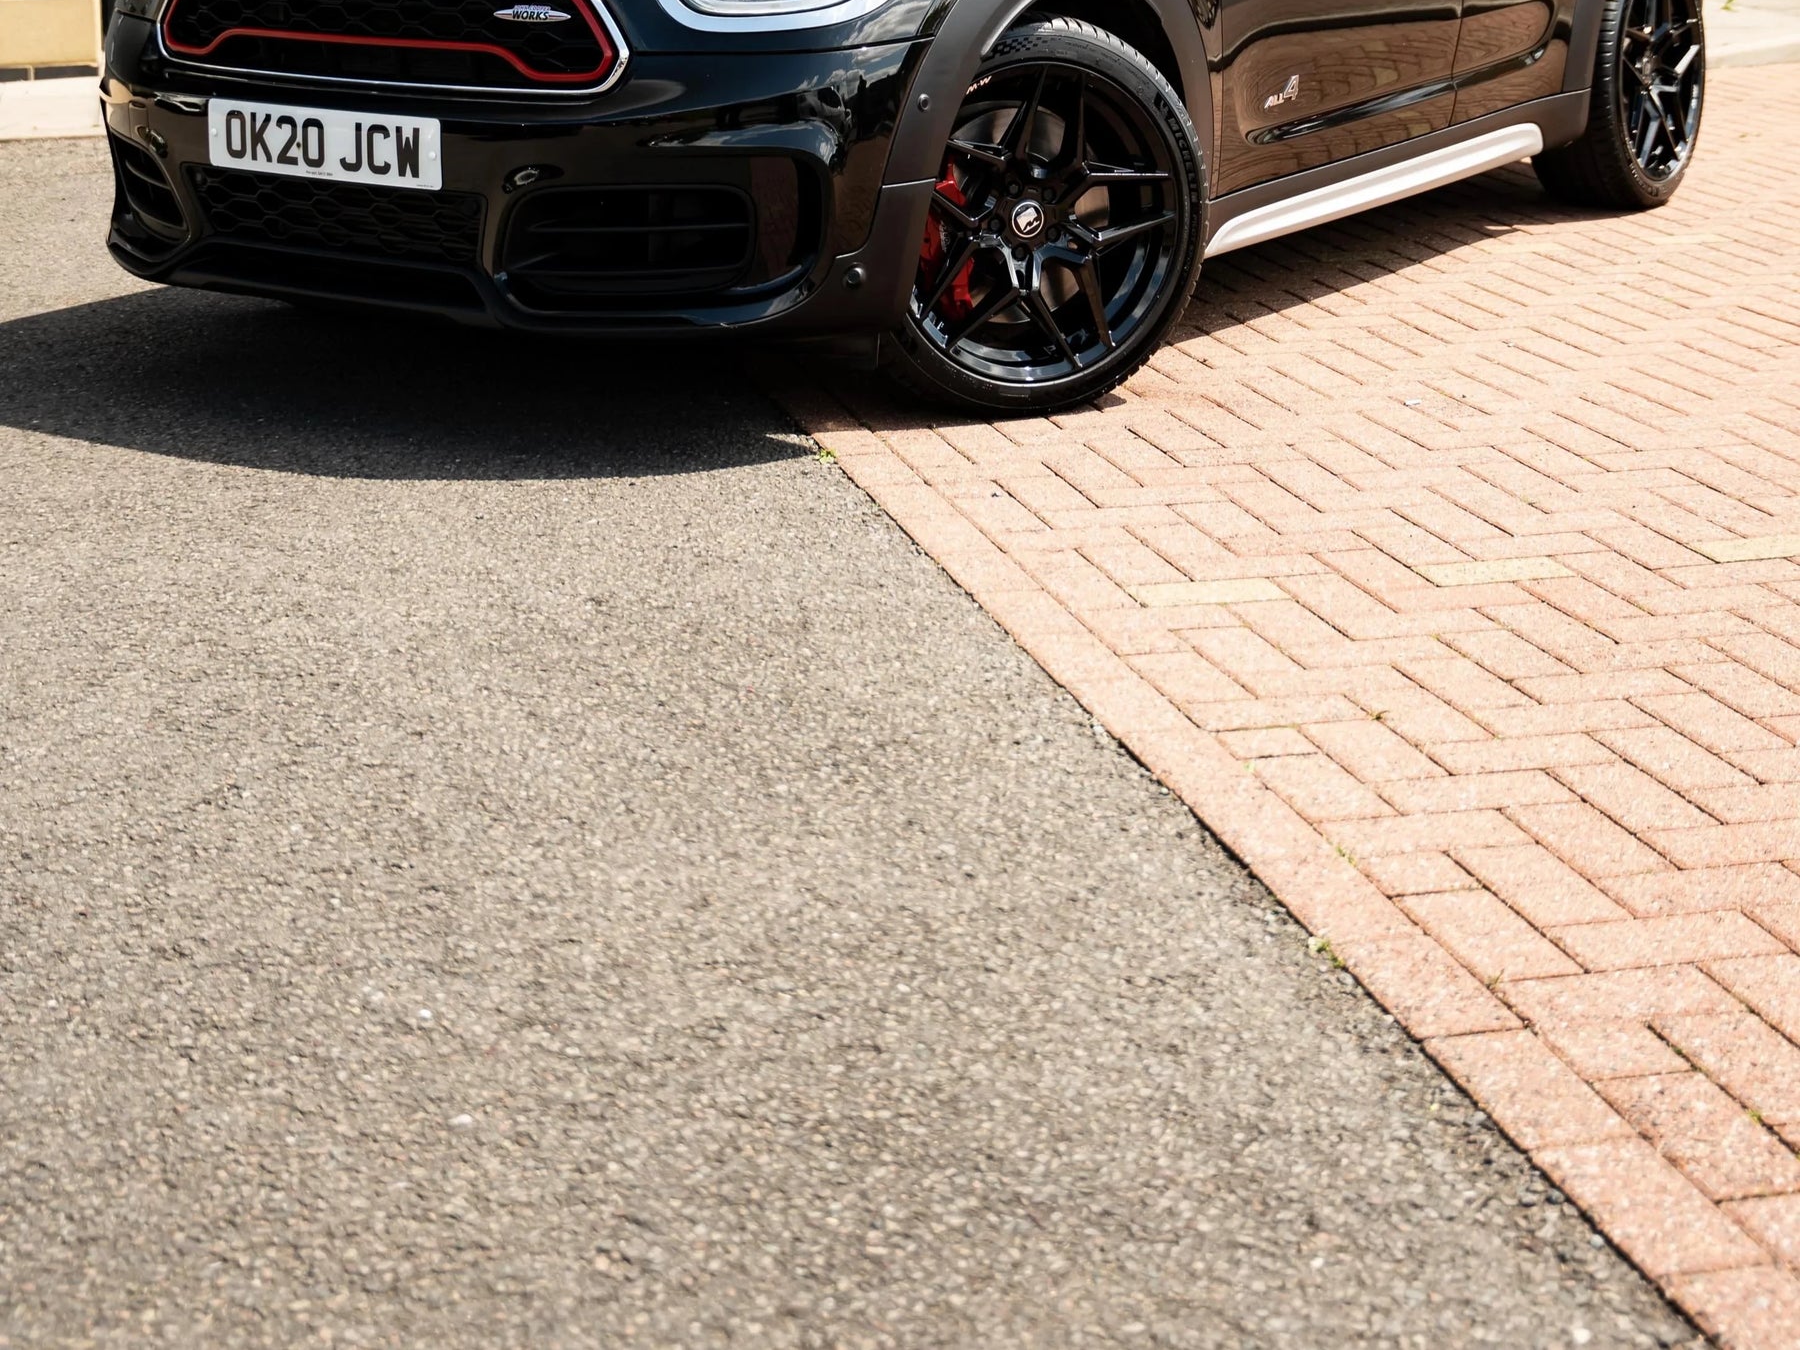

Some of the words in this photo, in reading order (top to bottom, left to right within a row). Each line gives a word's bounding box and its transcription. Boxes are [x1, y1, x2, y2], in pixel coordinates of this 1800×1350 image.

[512, 10, 550, 21] WORKS
[225, 109, 325, 168] OK20
[339, 122, 420, 178] JCW
[1167, 117, 1198, 203] MICHELIN
